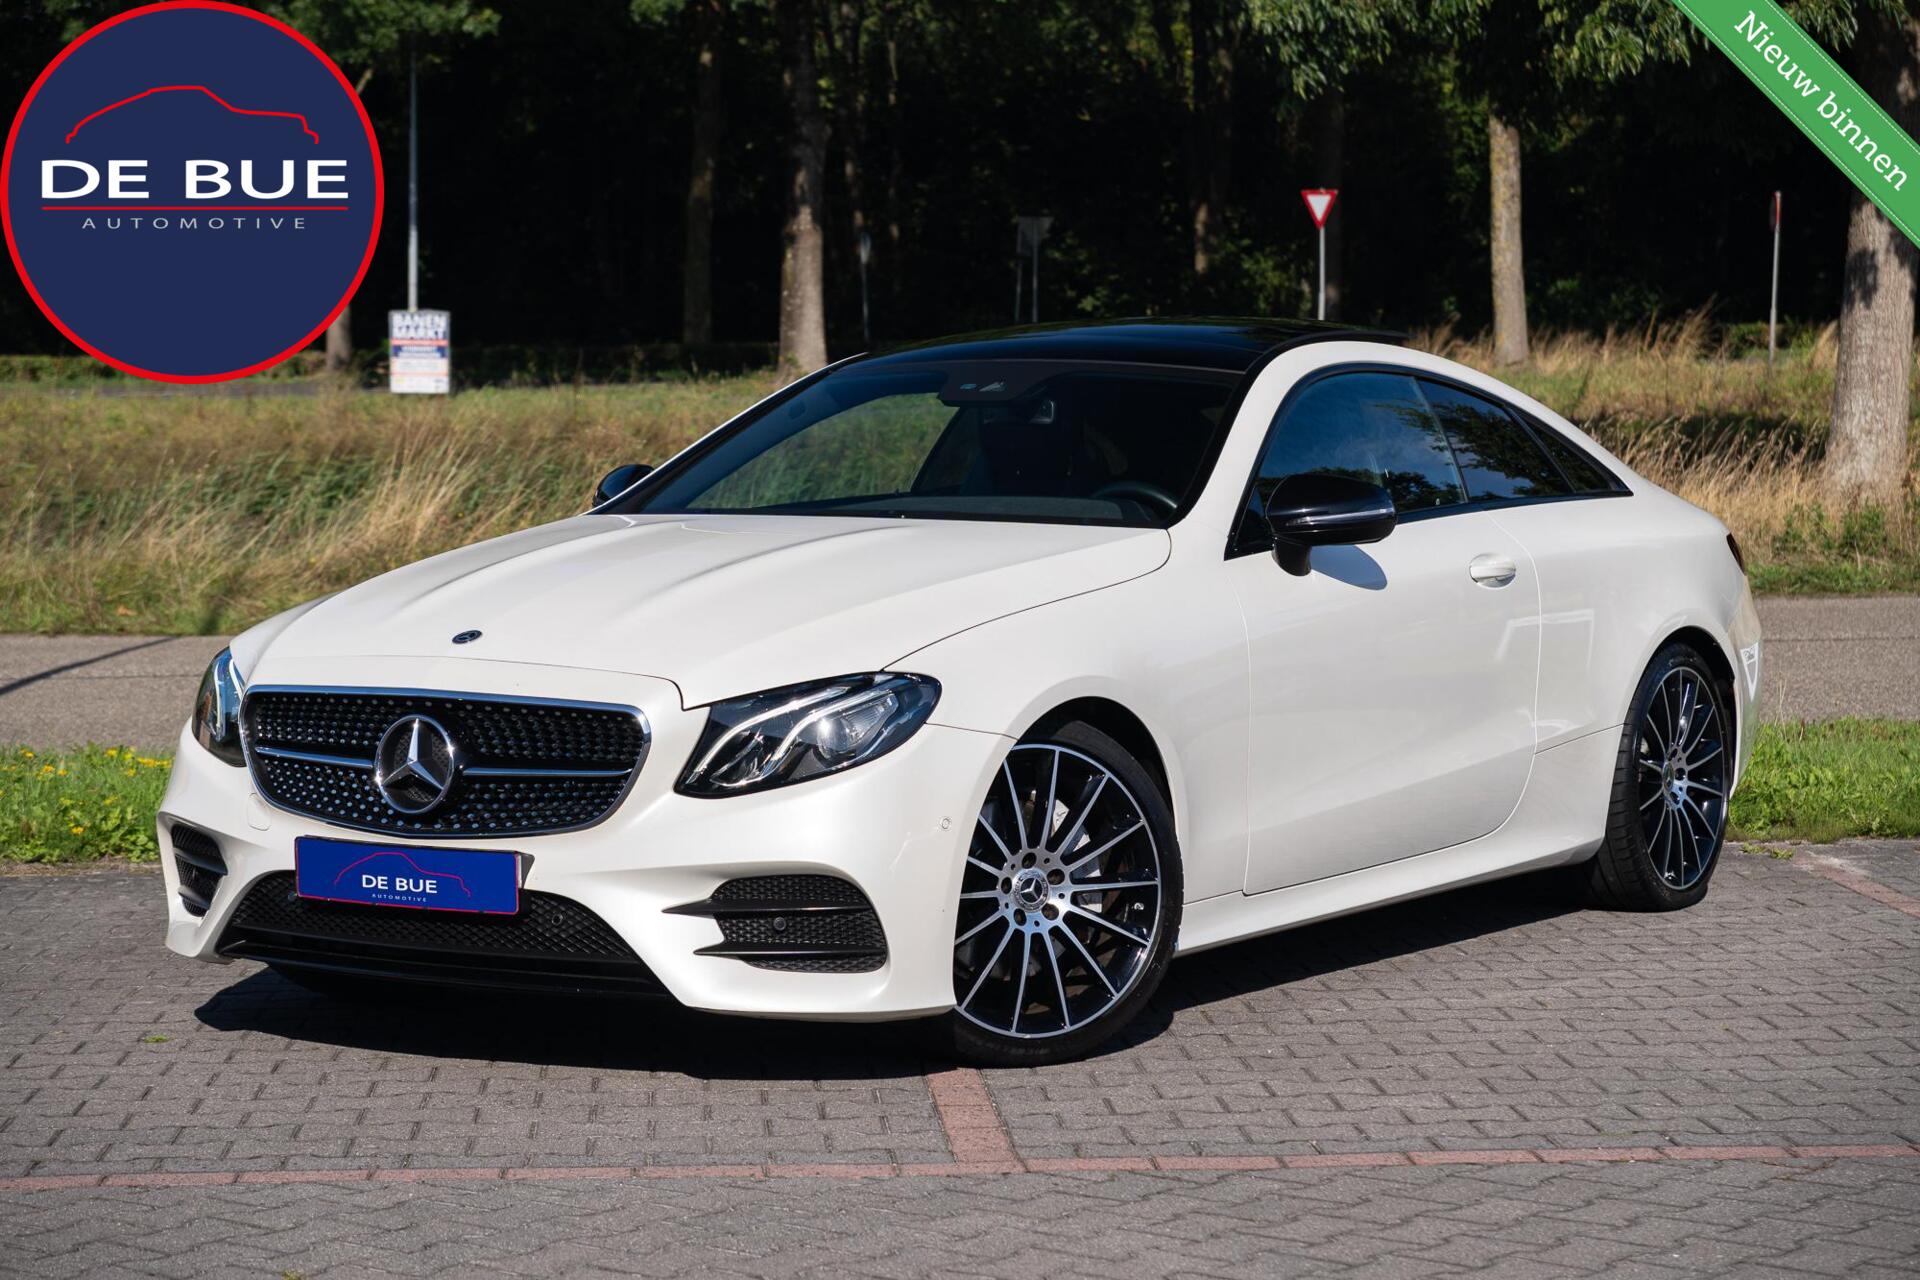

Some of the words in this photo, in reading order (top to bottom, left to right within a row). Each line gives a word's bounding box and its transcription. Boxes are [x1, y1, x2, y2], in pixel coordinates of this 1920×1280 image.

[362, 874, 388, 890] DE
[395, 877, 437, 893] BUE
[372, 893, 427, 902] AUTOMOTIVE
